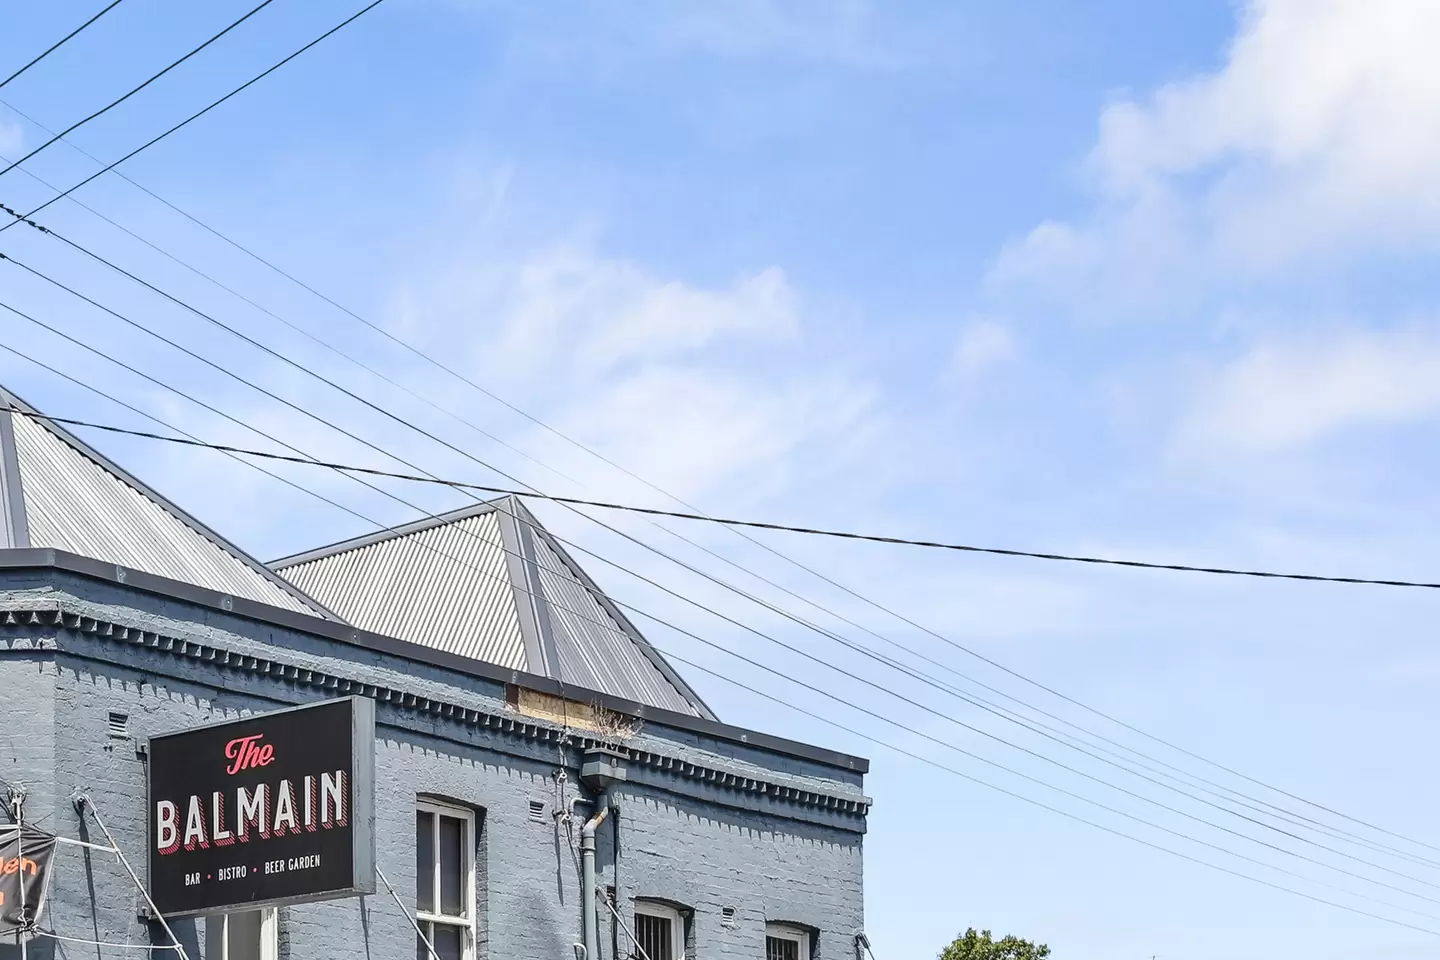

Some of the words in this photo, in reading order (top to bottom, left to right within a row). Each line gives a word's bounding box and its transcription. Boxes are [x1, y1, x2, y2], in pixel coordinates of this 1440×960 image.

[224, 733, 275, 775] The
[156, 769, 347, 855] BALMAIN
[185, 872, 201, 886] BAR
[218, 865, 247, 881] BISTRO
[264, 859, 285, 875] BEER
[288, 854, 321, 871] GARDEN
